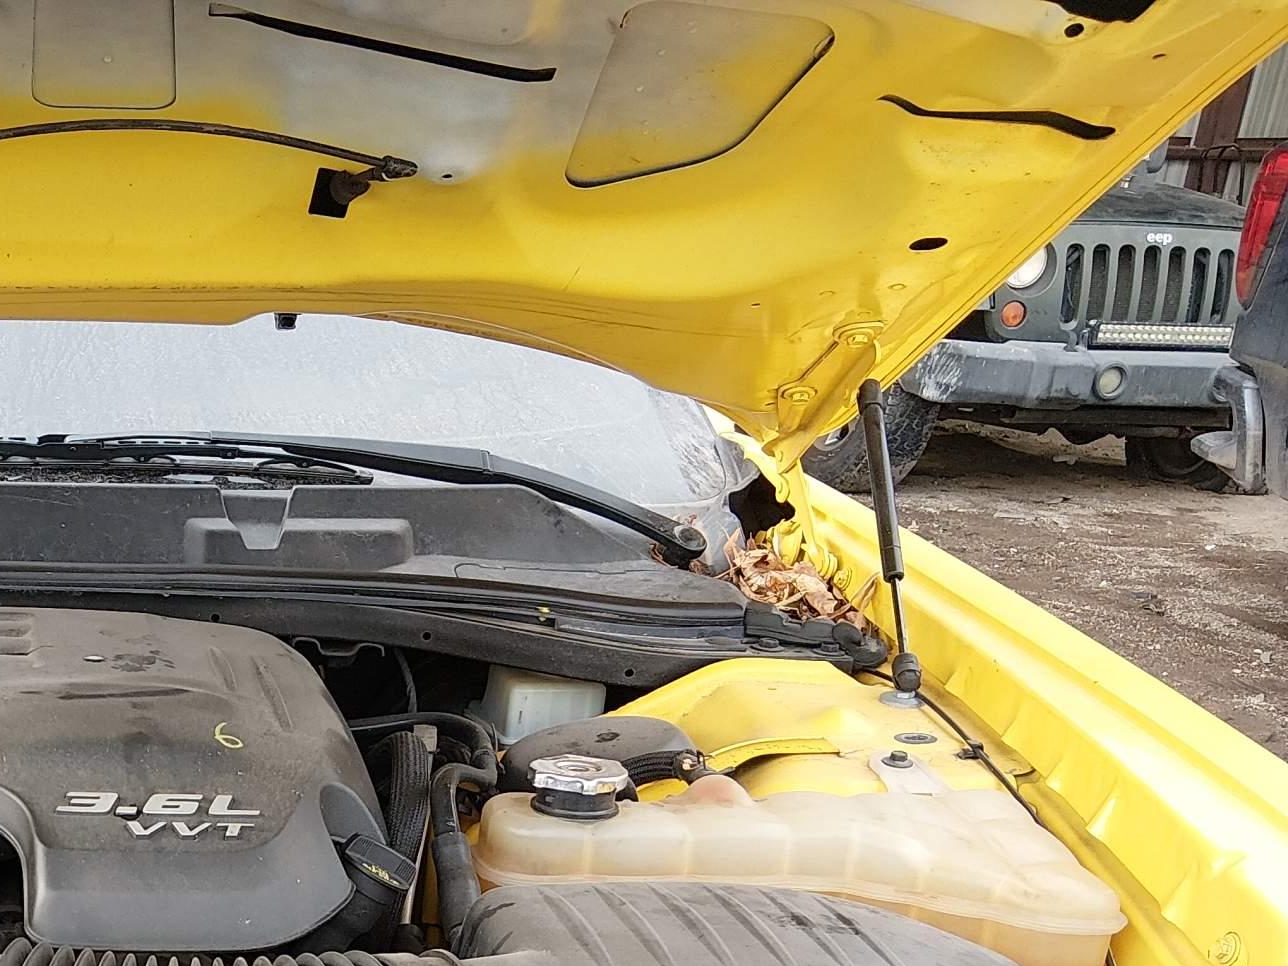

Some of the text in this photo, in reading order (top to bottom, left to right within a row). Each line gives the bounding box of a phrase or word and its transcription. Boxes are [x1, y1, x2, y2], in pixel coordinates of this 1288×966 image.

[213, 721, 245, 749] 6
[55, 791, 261, 817] 3.6L
[126, 821, 256, 840] VVT
